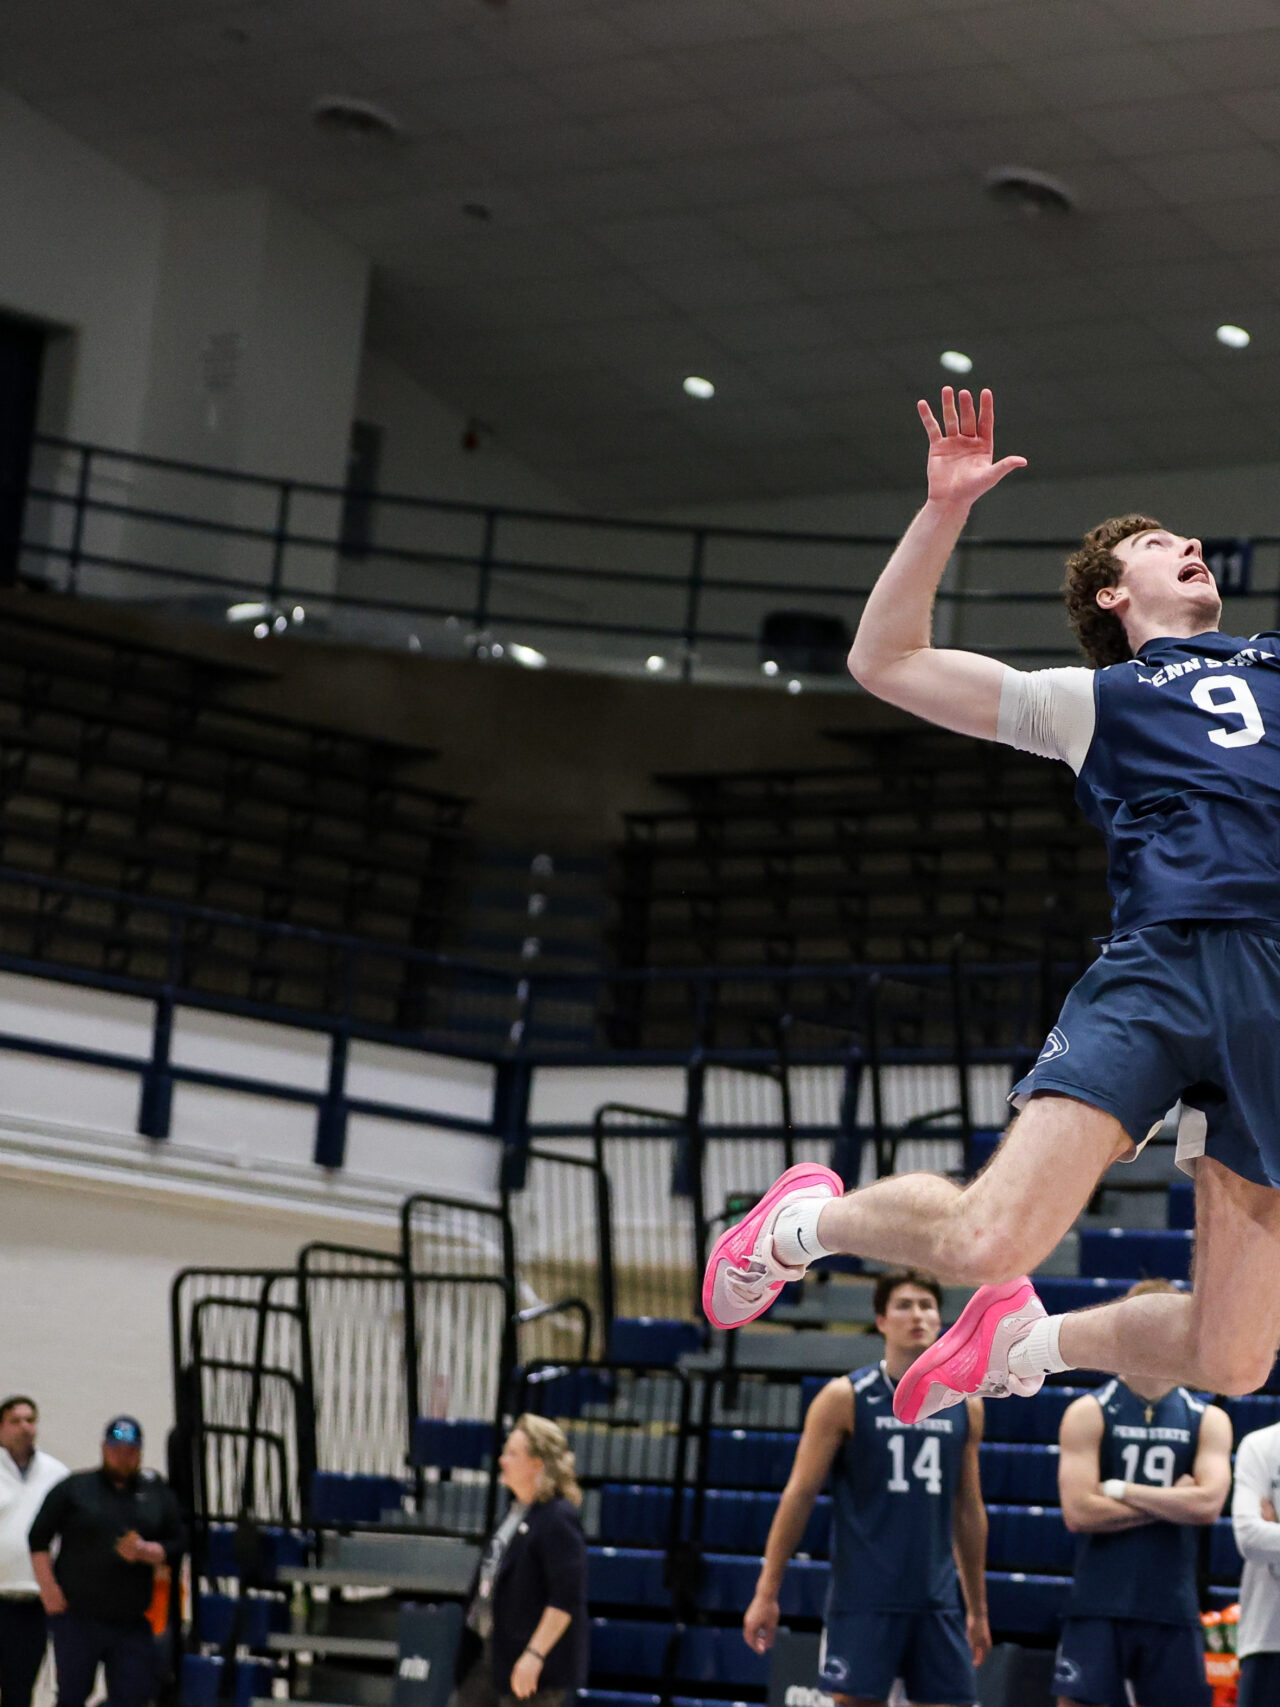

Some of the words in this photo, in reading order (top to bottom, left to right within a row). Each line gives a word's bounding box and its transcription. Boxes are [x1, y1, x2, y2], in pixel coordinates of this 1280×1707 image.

[1190, 674, 1266, 749] 9
[887, 1434, 942, 1494] 14
[1121, 1443, 1176, 1487] 19
